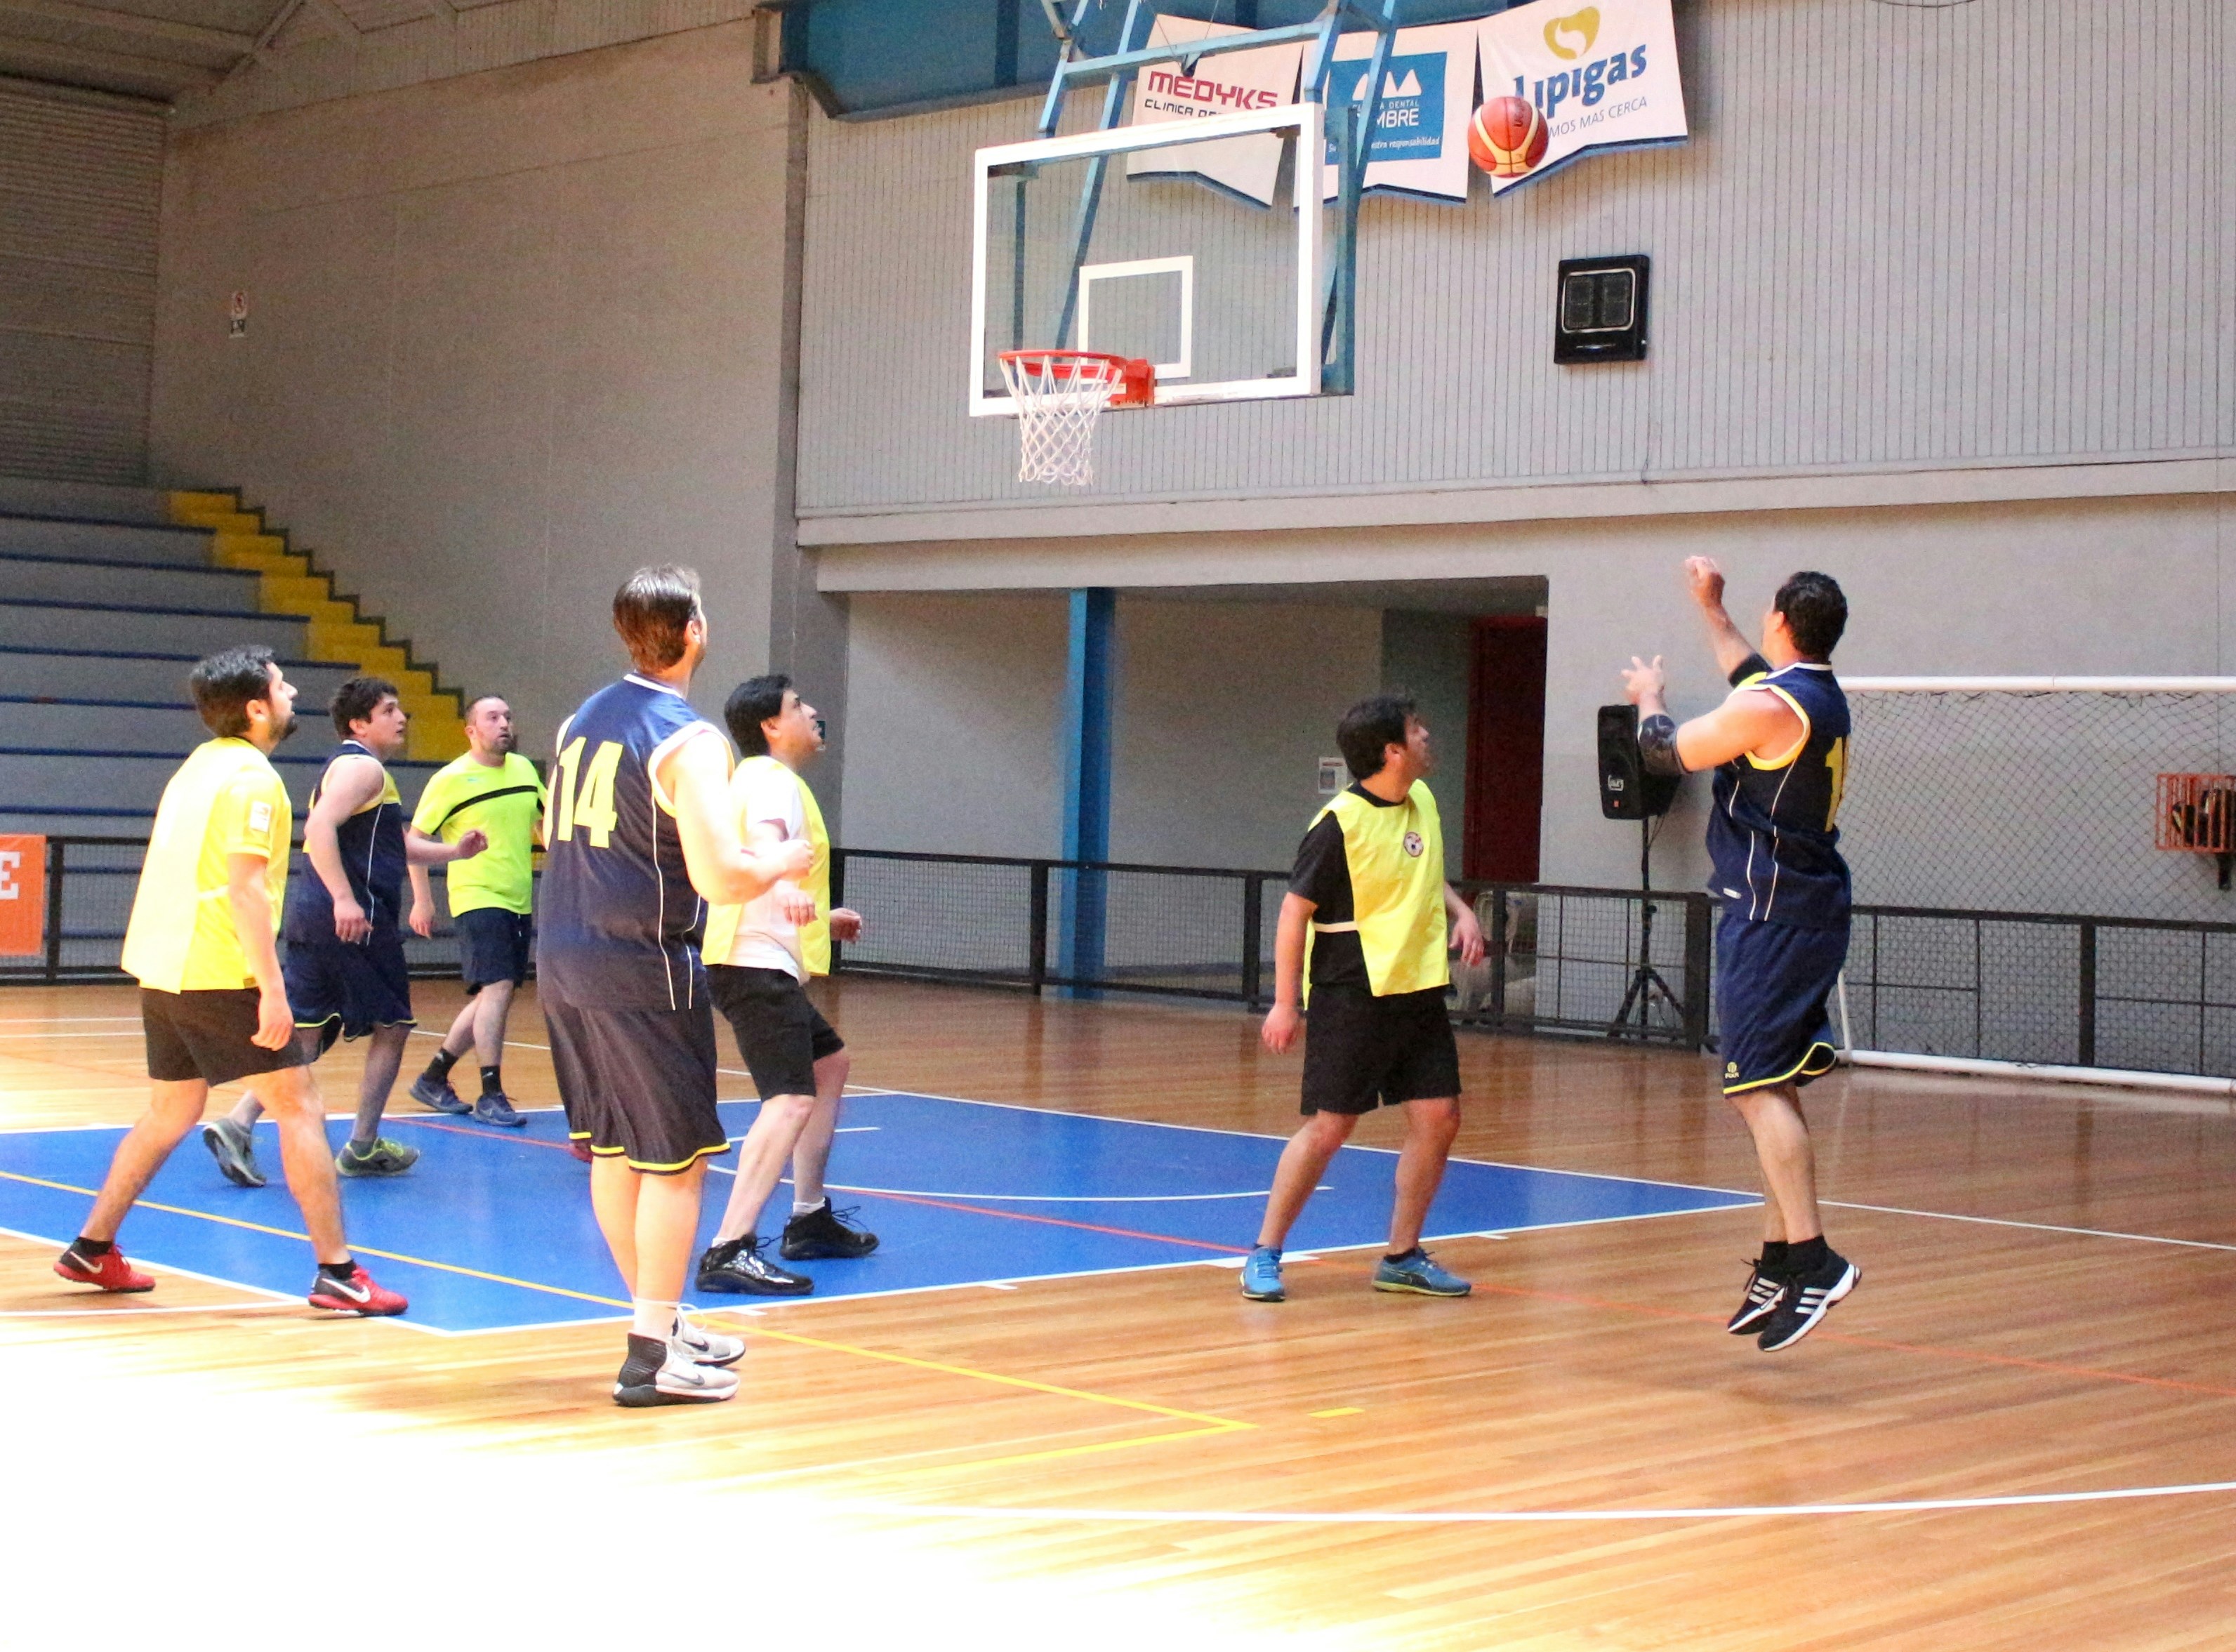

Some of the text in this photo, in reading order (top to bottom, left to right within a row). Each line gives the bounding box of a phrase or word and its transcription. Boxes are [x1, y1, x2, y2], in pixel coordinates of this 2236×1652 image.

[1144, 98, 1193, 117] CLINICA
[1148, 70, 1278, 110] MEDYKS
[1389, 100, 1420, 110] DENTAL
[1357, 108, 1420, 129] MBRE
[1548, 96, 1647, 138] MOS MAS CERCA
[557, 736, 624, 849] 14
[1825, 734, 1850, 833] 1
